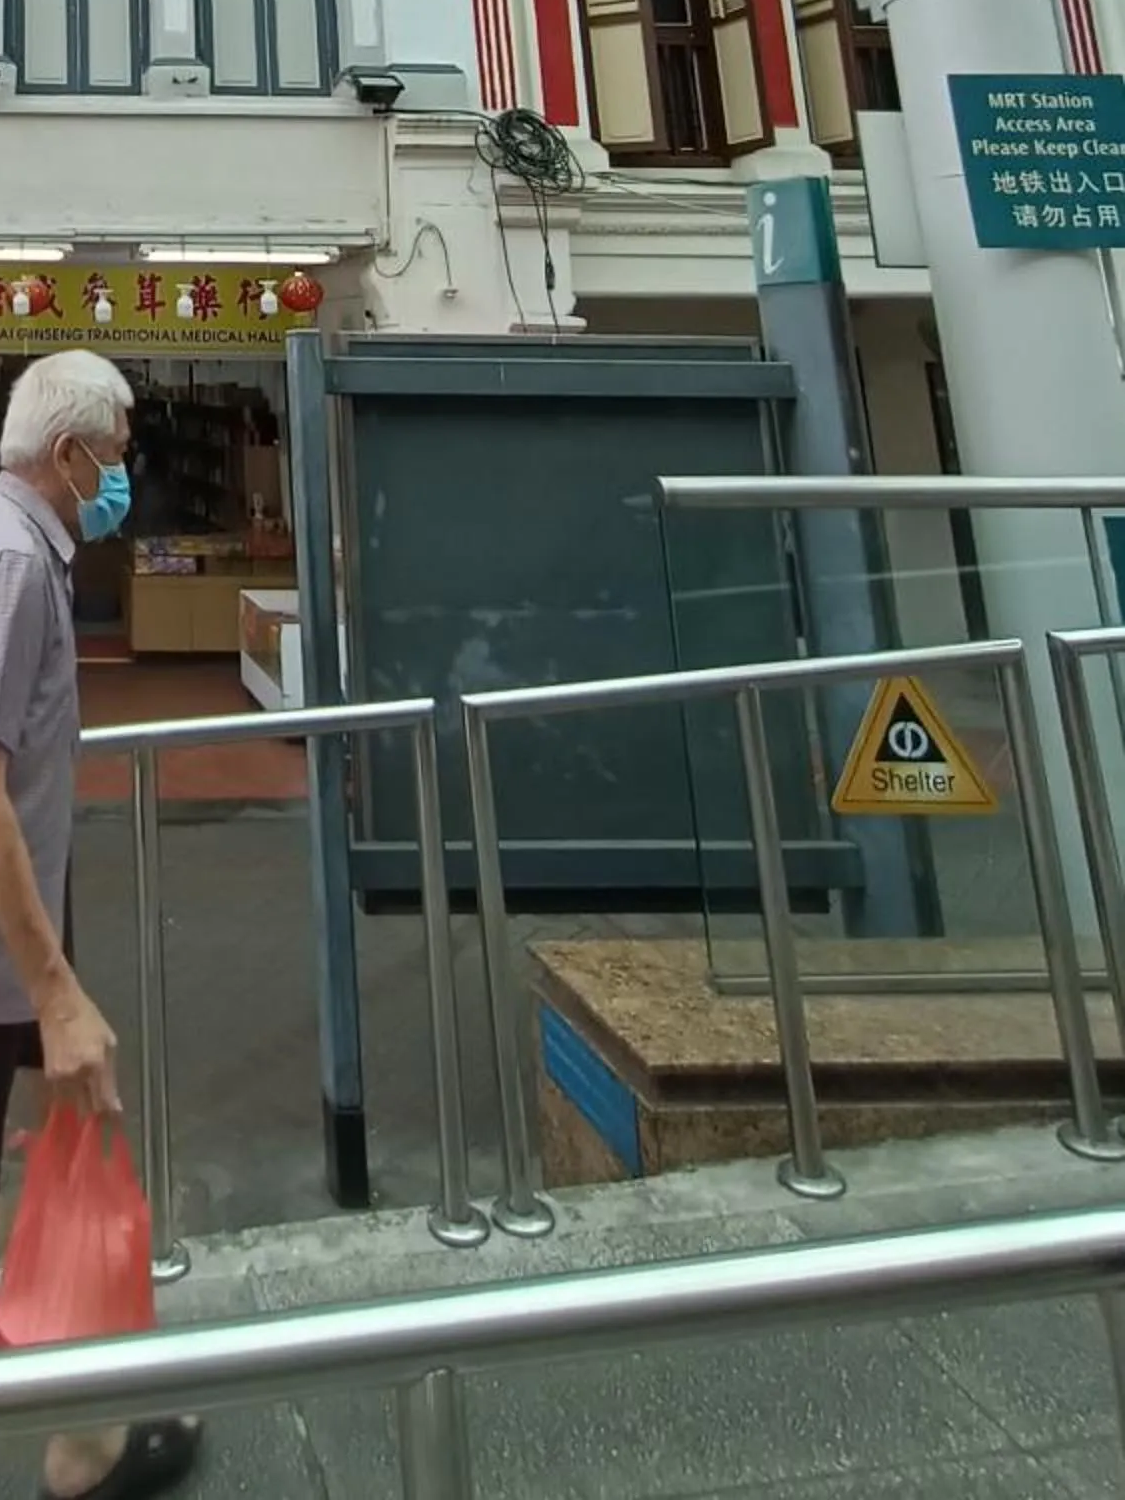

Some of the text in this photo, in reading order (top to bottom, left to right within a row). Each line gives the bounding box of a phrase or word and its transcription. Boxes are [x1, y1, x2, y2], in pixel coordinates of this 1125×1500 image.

[988, 92, 1094, 108] MRT Station
[995, 116, 1096, 132] Access Area
[971, 140, 1029, 156] Please
[1034, 140, 1078, 158] Keep
[992, 169, 1125, 194] 地铁出入口
[1012, 204, 1121, 228] 请勿占用
[17, 328, 83, 341] GINSENG
[87, 328, 178, 342] TRADITIONAL
[182, 329, 244, 343] MEDICAL
[248, 330, 282, 343] HALL
[871, 767, 955, 792] Shelter
